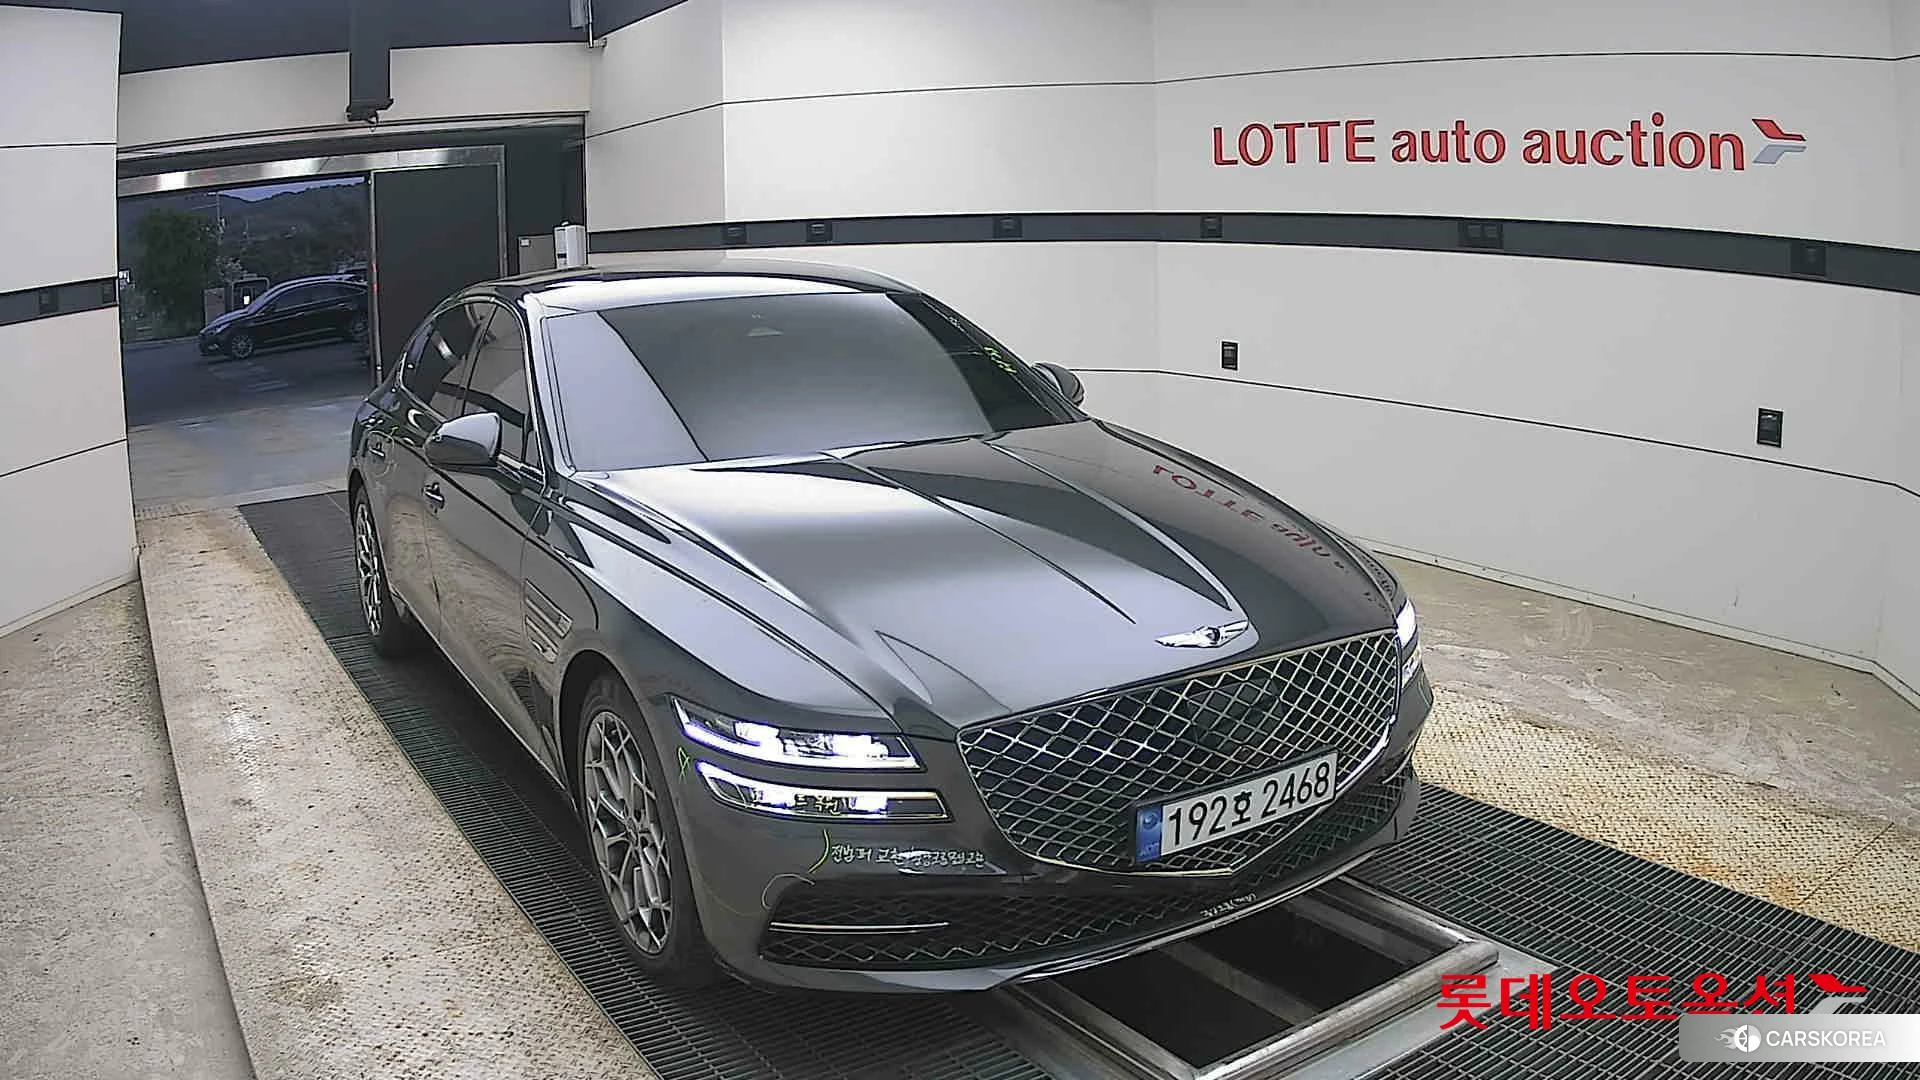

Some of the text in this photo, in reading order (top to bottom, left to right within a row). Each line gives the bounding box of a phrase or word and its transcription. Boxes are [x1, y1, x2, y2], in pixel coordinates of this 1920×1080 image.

[1212, 111, 1746, 172] LOTTE auto auction
[1168, 762, 1330, 847] 192호 2468
